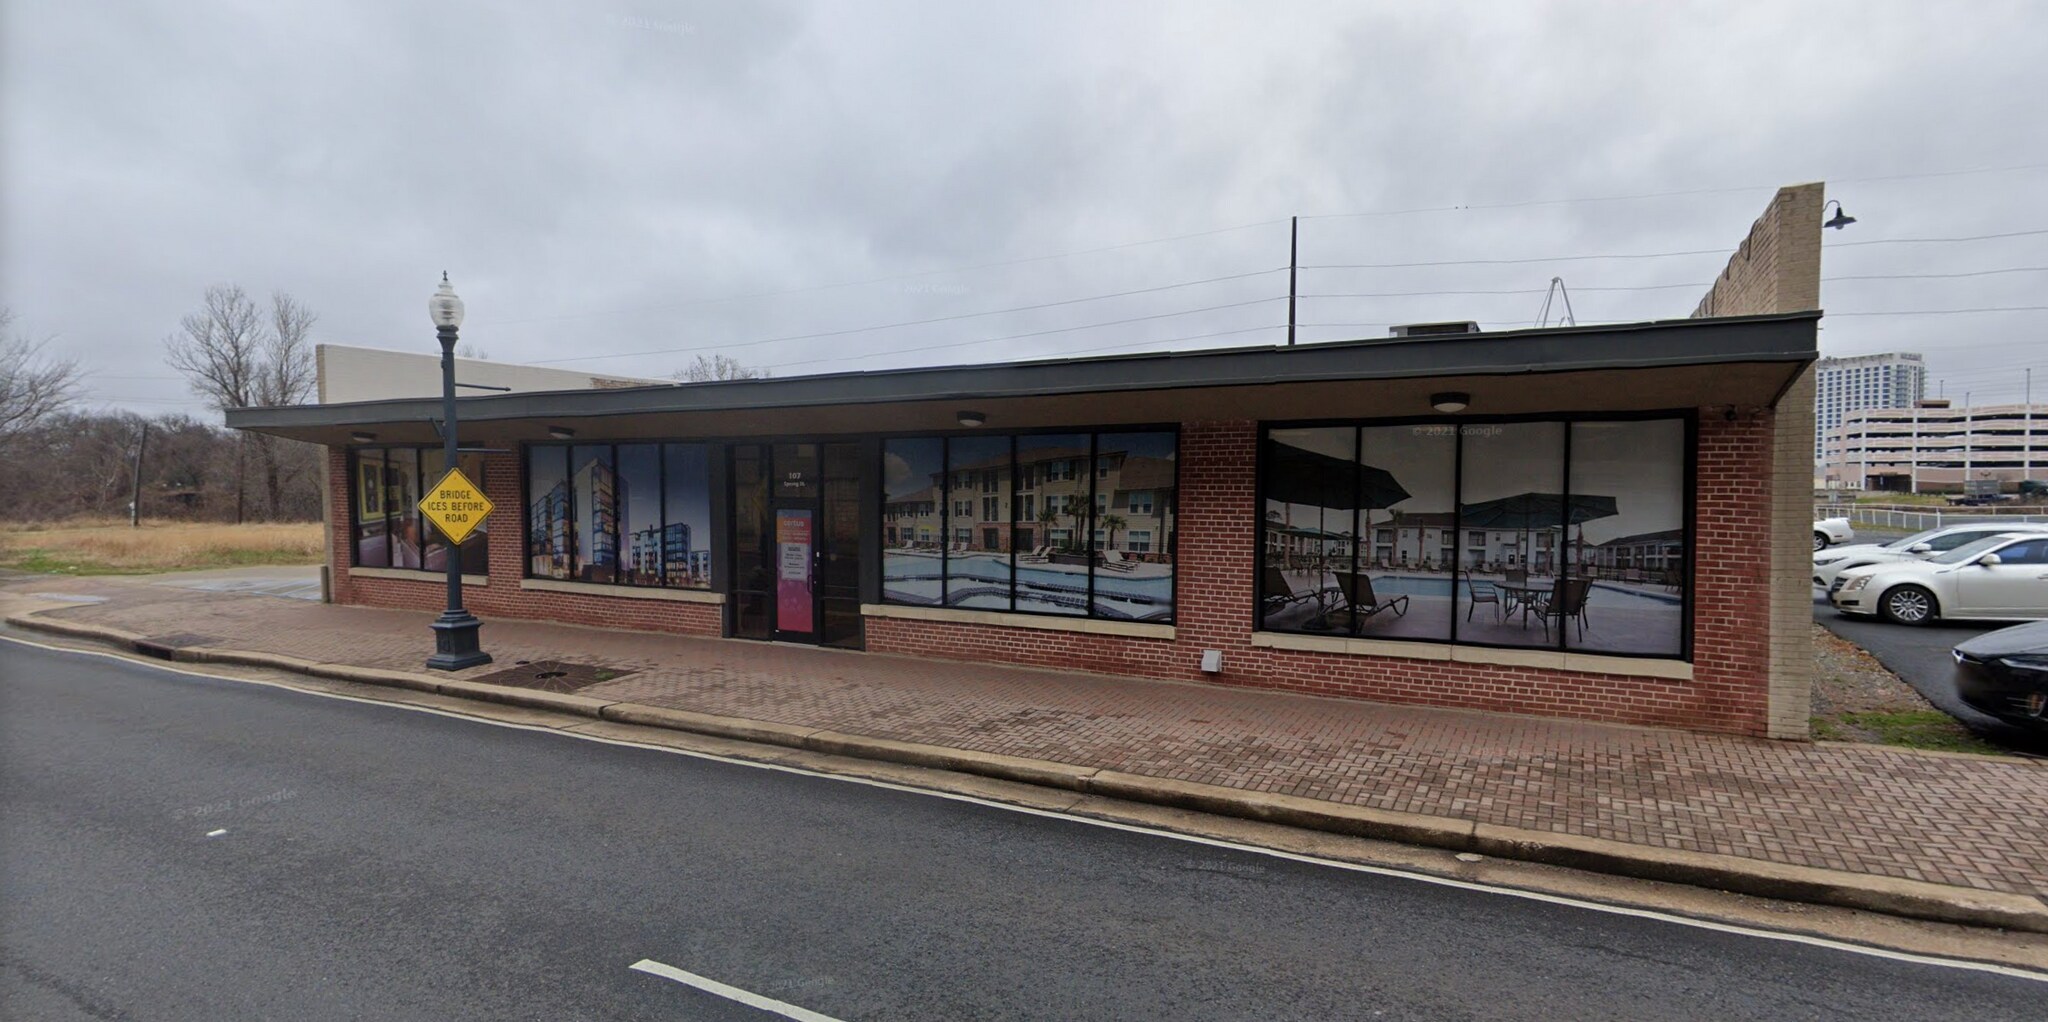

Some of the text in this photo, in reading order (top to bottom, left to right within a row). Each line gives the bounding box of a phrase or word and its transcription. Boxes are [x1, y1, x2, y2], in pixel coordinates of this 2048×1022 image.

[440, 490, 471, 499] BRIDGE
[428, 501, 484, 511] ICES BEFORE
[445, 513, 468, 522] ROAD
